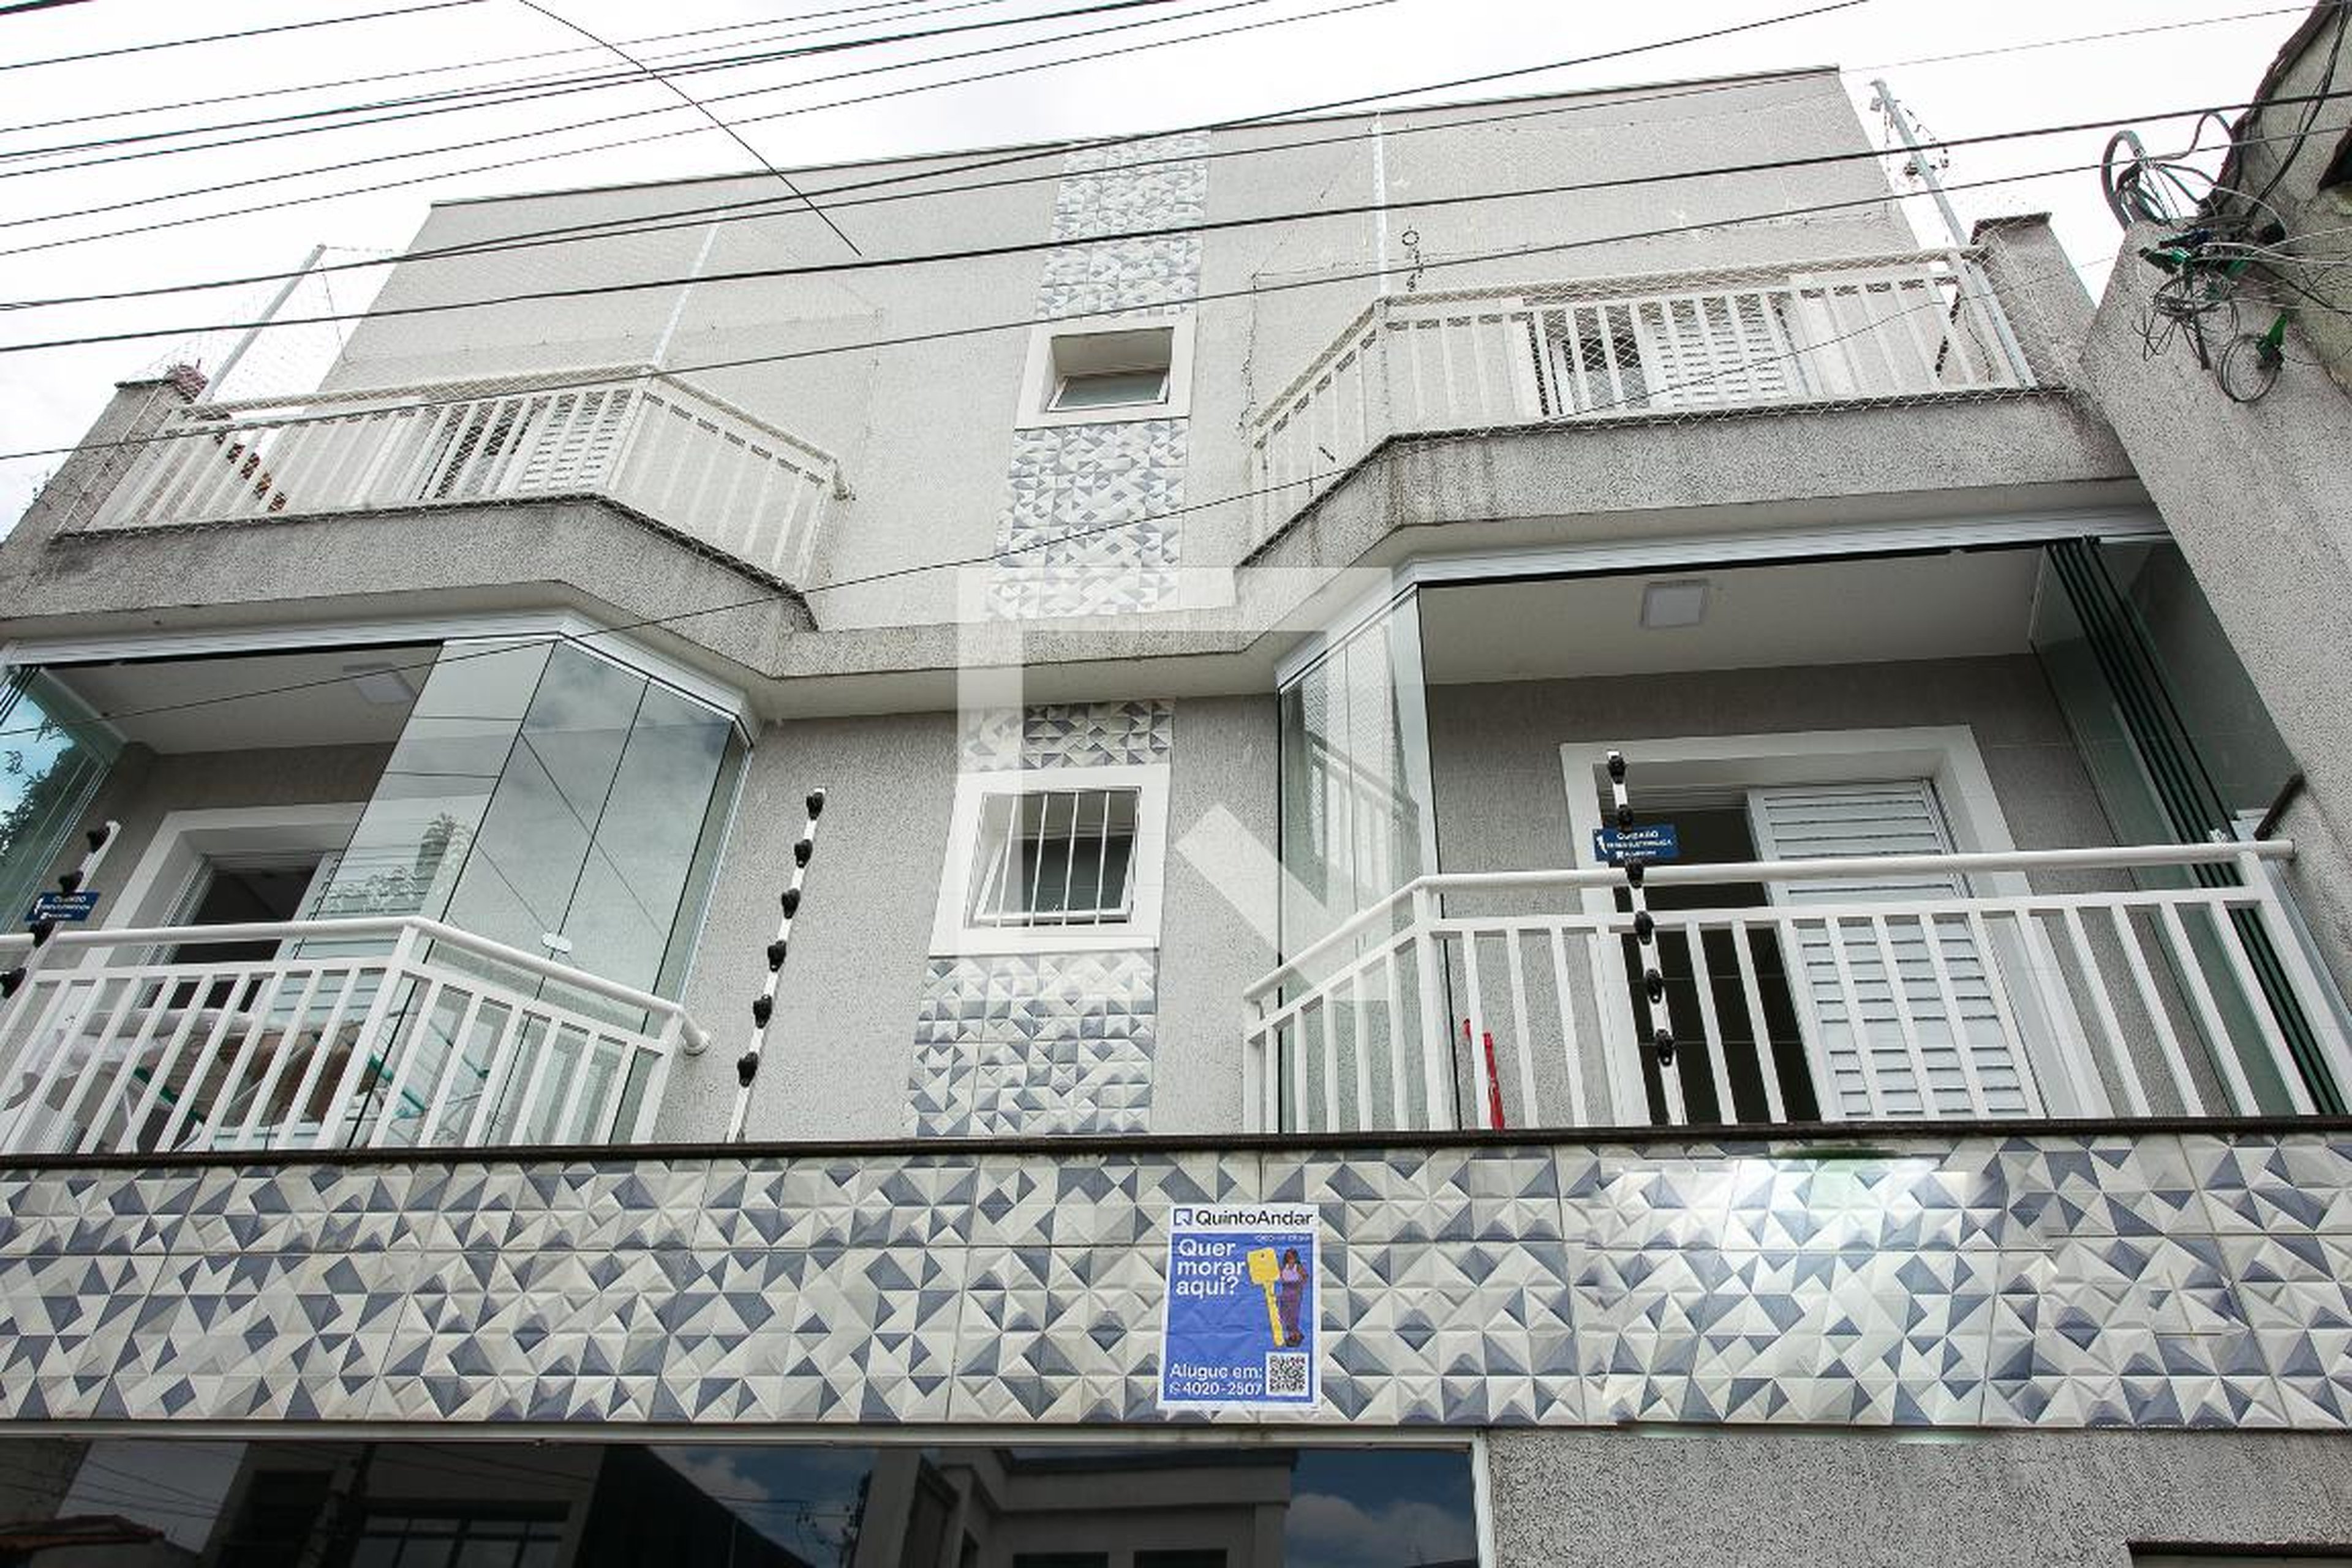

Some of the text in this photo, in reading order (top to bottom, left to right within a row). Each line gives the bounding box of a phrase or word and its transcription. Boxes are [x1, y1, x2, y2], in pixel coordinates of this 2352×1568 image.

[1196, 1209, 1313, 1226] QuintoAndar
[1178, 1238, 1236, 1256] Quer
[1177, 1261, 1246, 1275] morar
[1176, 1275, 1238, 1299] aqui?
[1169, 1363, 1263, 1381] Alugue em:
